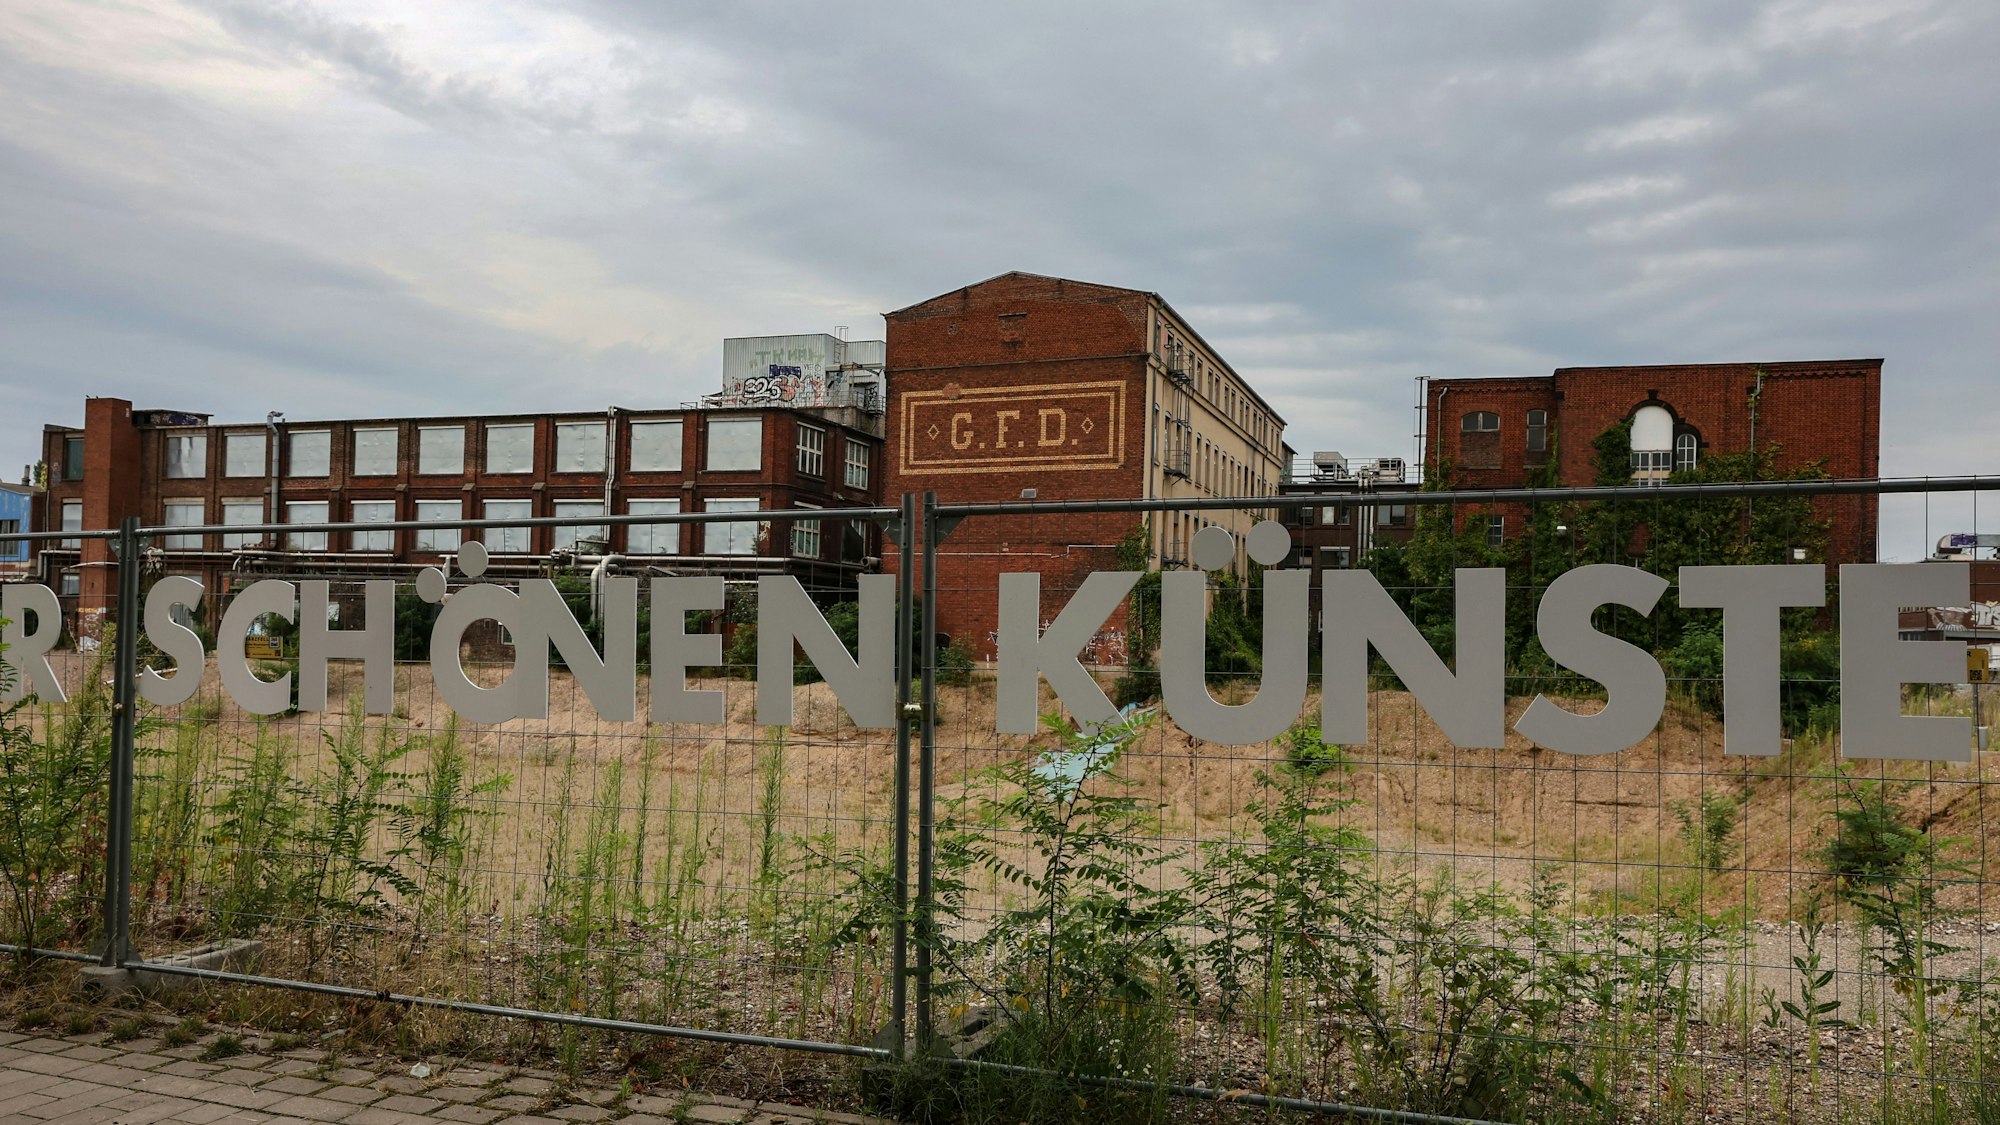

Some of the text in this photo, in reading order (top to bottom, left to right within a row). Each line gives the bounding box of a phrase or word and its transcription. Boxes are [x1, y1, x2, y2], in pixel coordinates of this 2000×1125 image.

[1, 520, 1972, 762] R SCHÖNEN KÜNSTE
